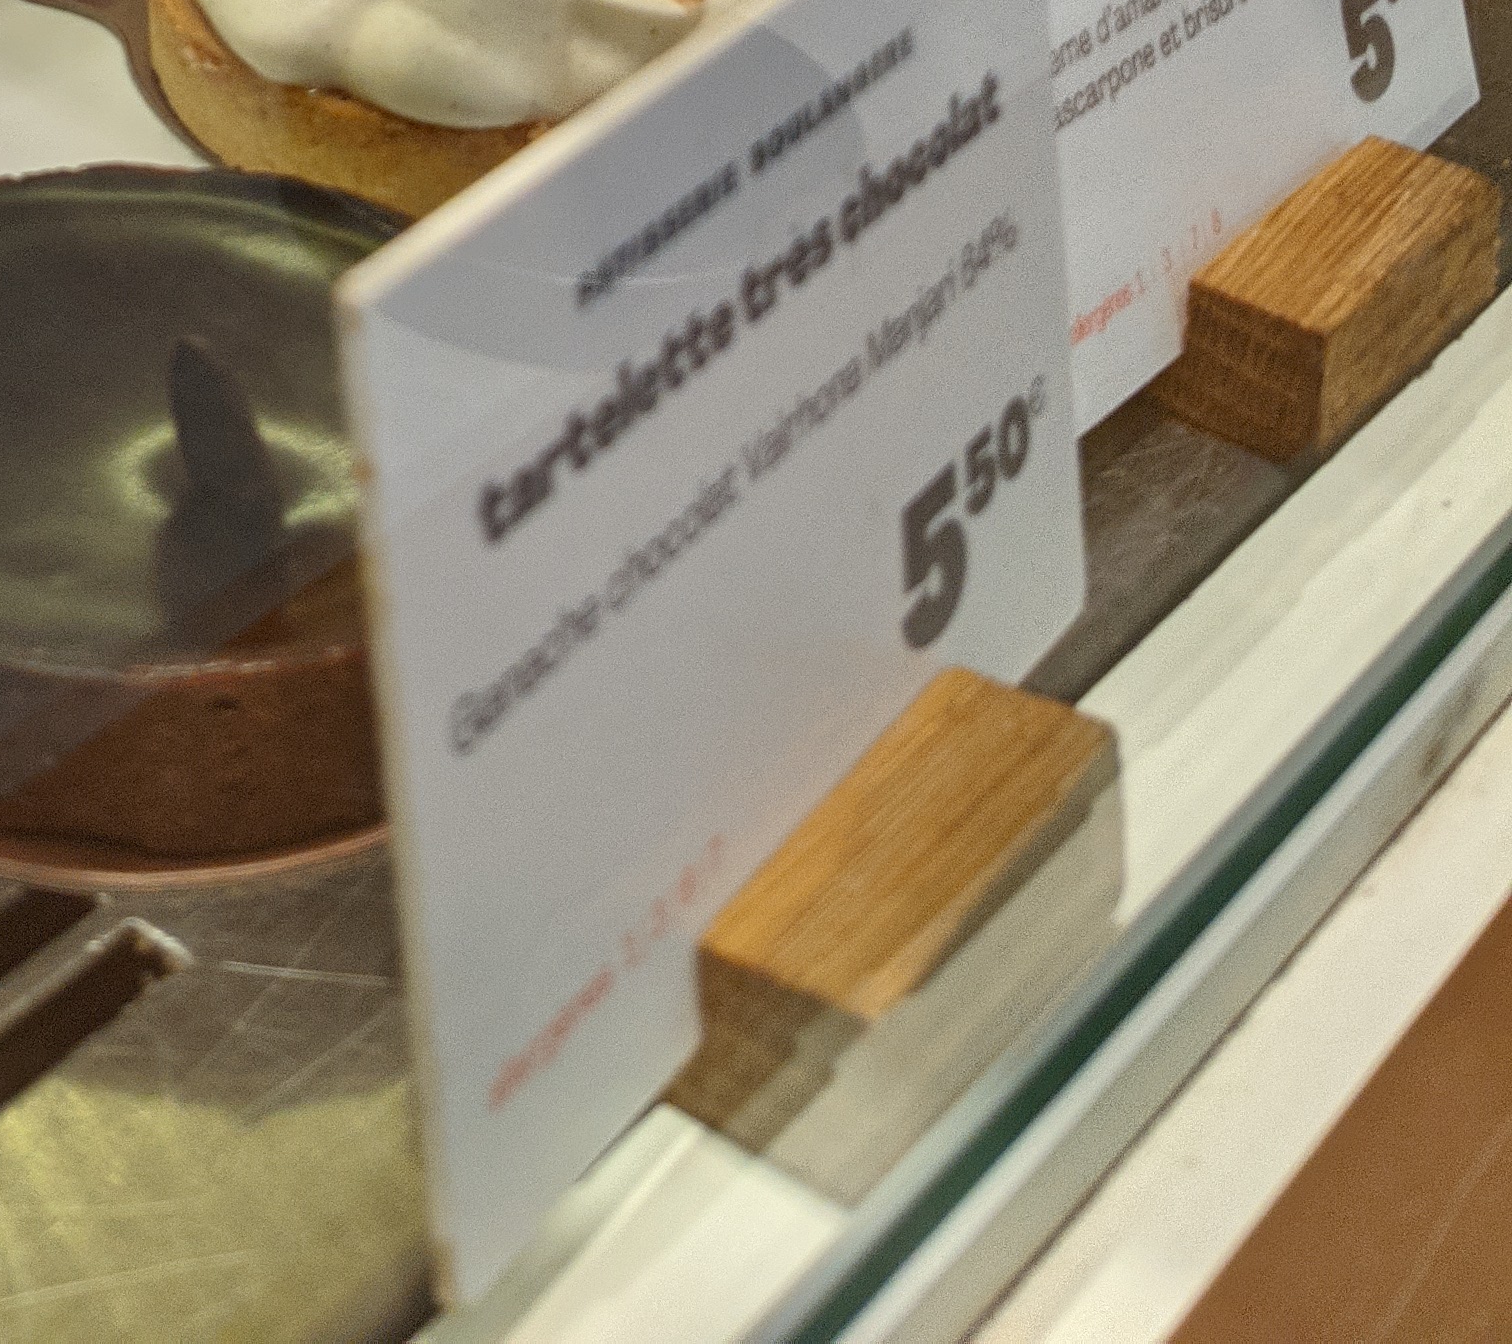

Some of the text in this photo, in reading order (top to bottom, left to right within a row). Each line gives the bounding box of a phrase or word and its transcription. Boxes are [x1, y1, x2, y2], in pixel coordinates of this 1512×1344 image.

[1159, 20, 1182, 58] et
[478, 298, 735, 545] tartelette
[839, 69, 1002, 244] chocolat
[605, 465, 737, 611] chocolat
